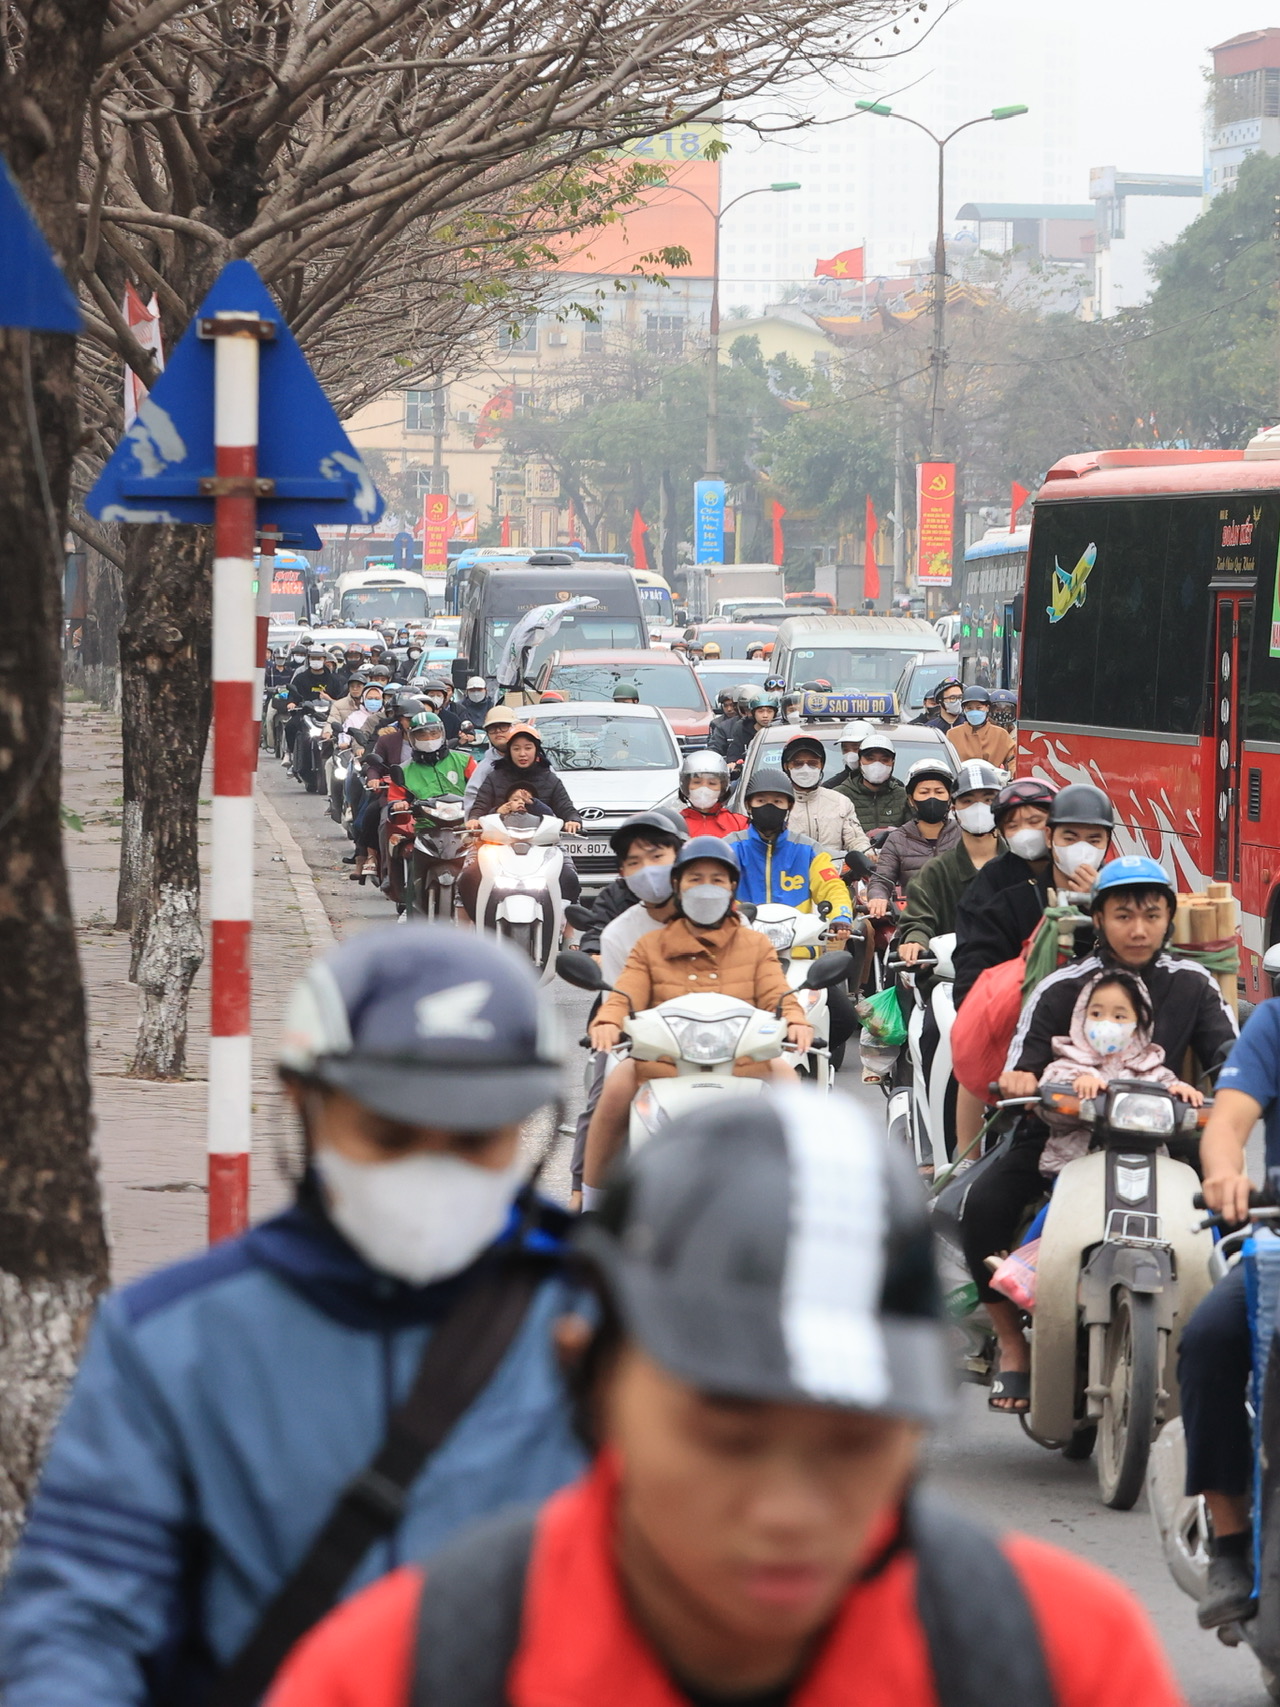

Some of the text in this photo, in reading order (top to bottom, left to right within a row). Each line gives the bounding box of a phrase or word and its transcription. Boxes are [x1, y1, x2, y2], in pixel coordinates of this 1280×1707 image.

[829, 700, 849, 713] SAO
[872, 699, 885, 713] ĐÔ
[564, 844, 617, 854] 30K-807.
[780, 870, 805, 892] be
